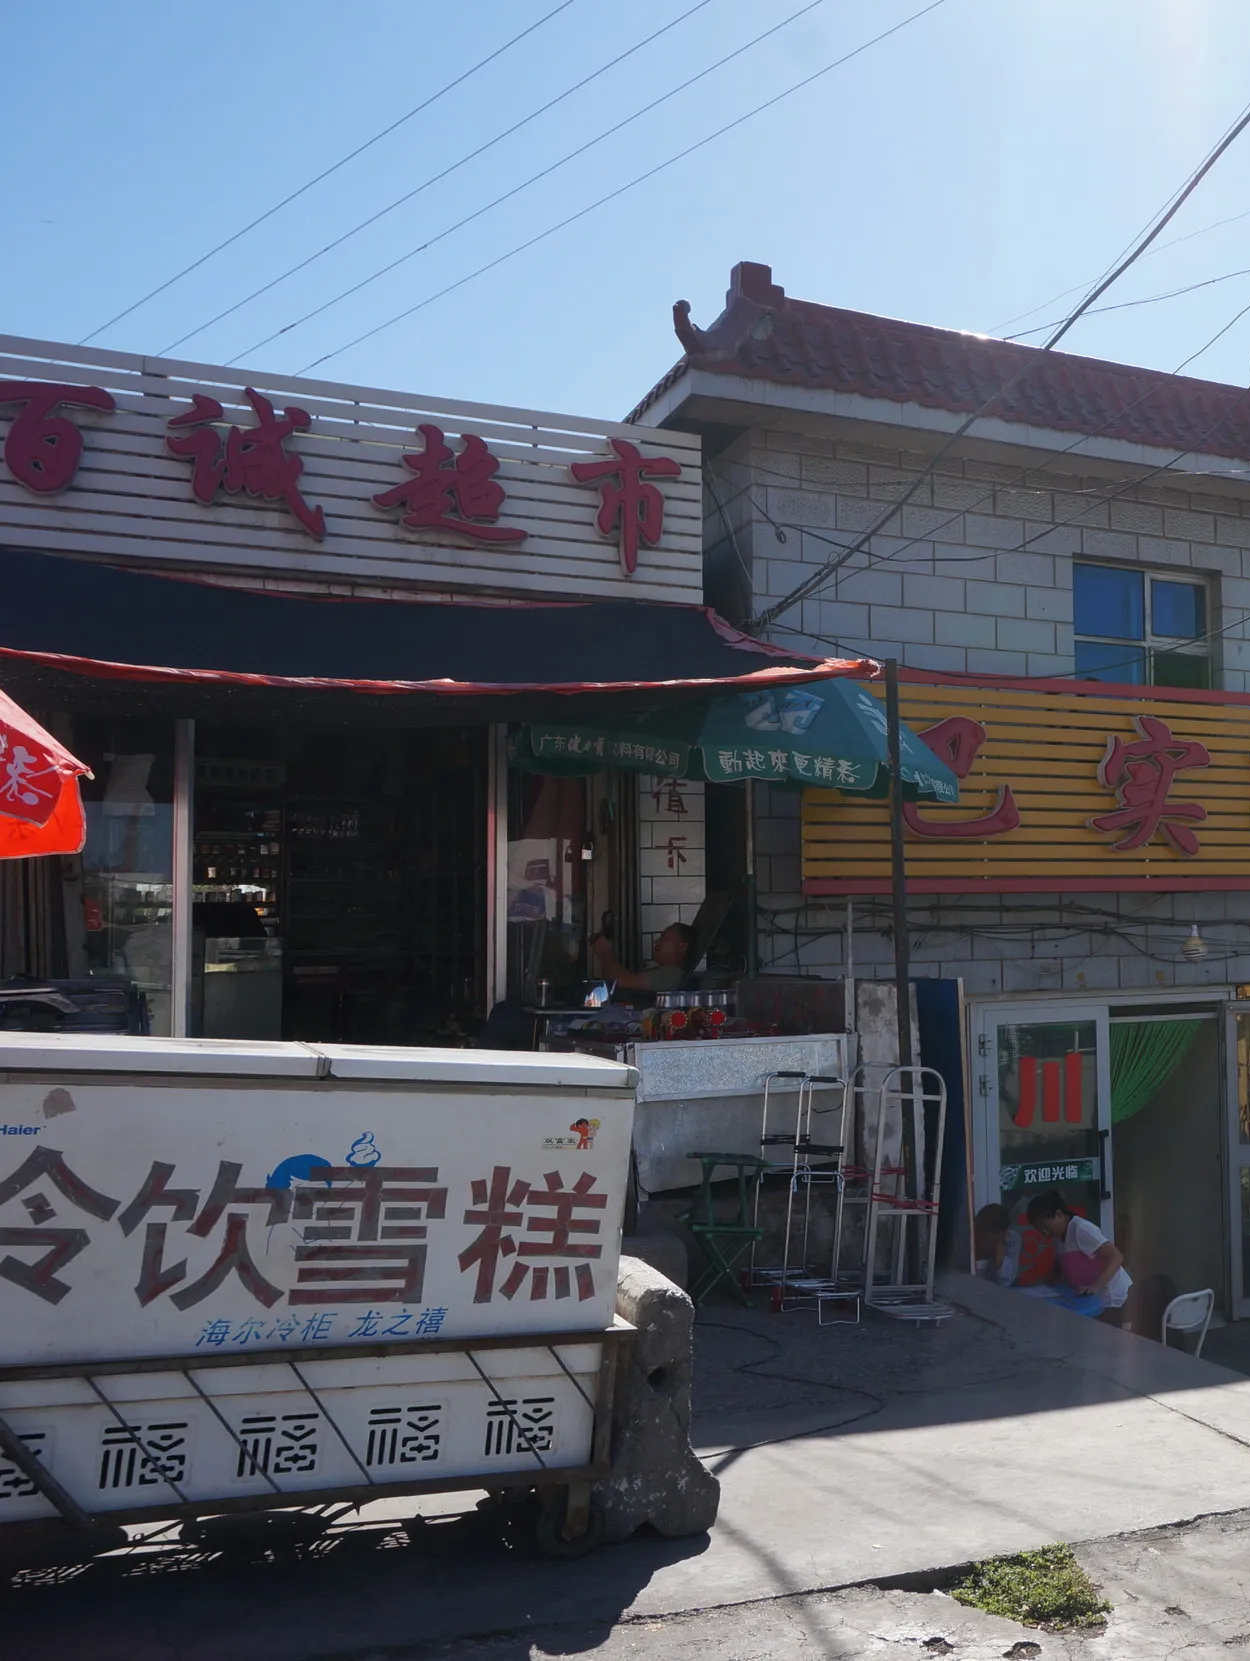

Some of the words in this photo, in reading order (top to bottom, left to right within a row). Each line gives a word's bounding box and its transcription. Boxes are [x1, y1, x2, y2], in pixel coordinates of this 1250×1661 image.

[0, 380, 682, 577] 百诚超市
[1023, 1165, 1079, 1185] 欢迎光临
[0, 1146, 609, 1307] 冷饮雪糕
[196, 1312, 338, 1347] 海尔冷柜
[348, 1307, 449, 1338] 龙之禧
